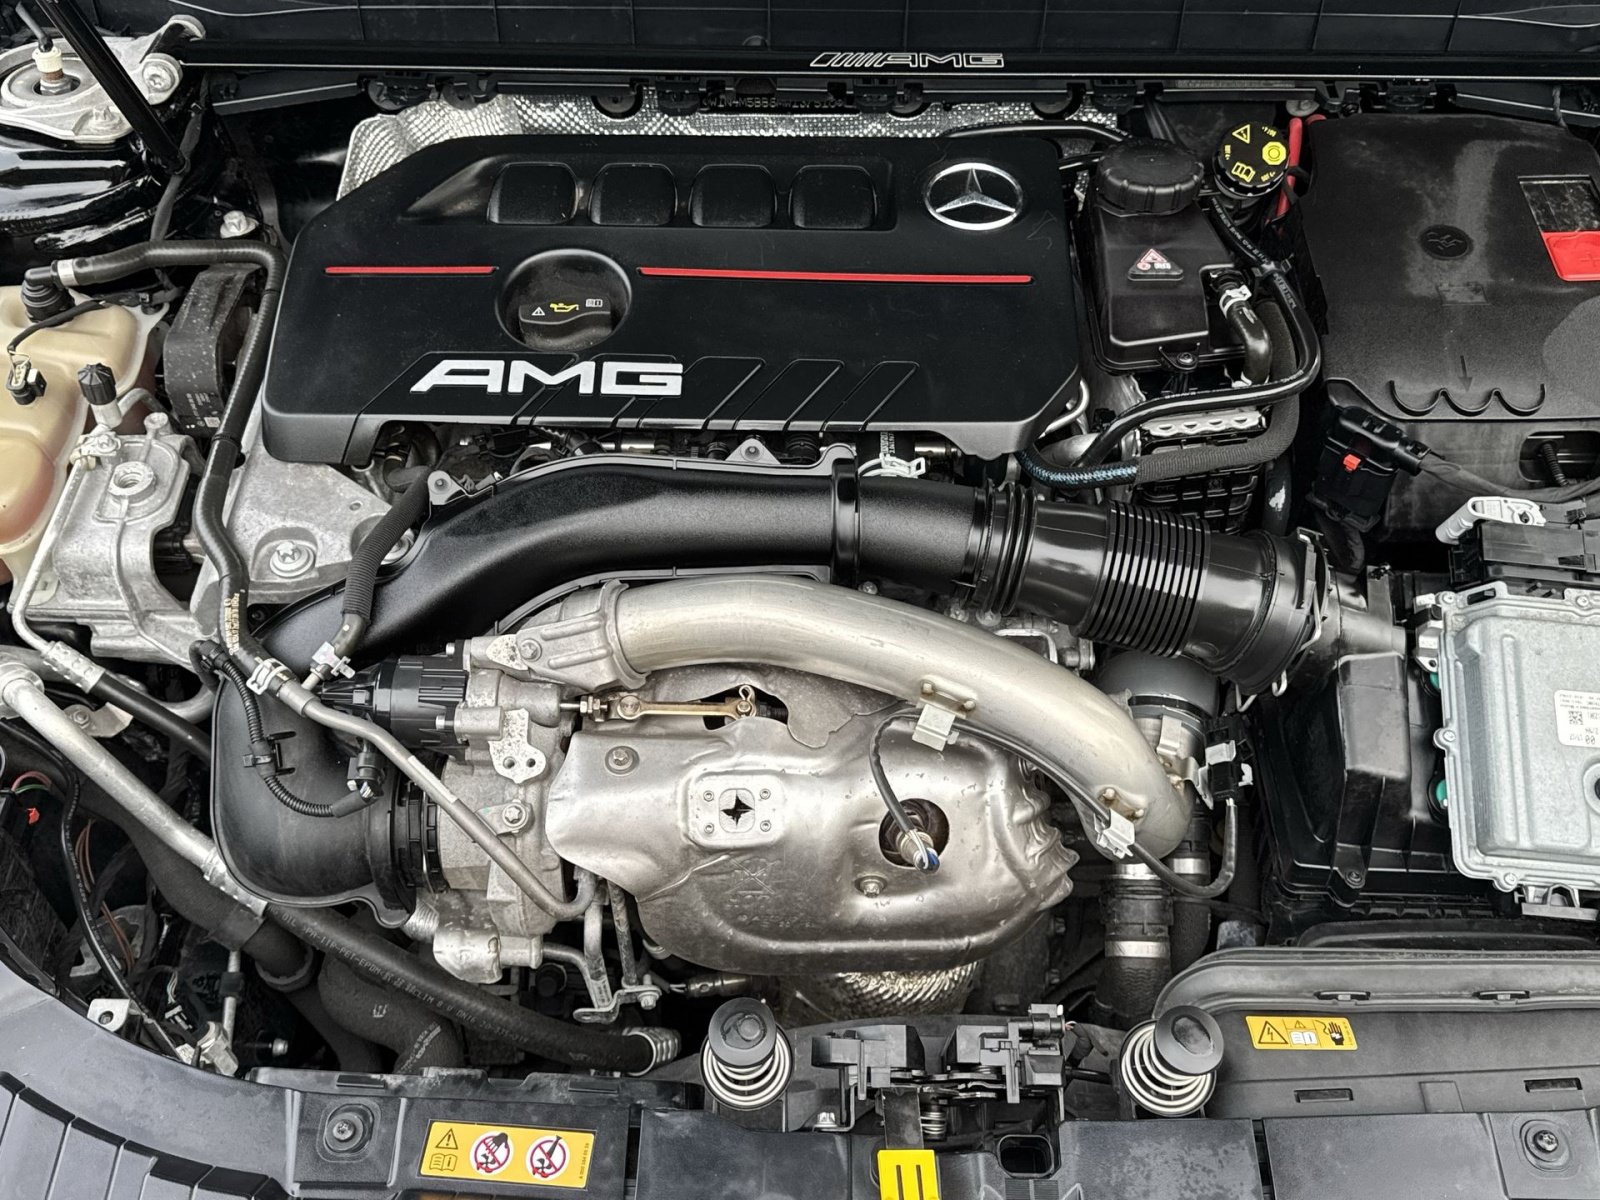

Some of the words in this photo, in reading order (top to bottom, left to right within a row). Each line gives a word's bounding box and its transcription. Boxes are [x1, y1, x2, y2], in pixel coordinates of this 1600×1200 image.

[873, 52, 1005, 68] AMG
[409, 360, 683, 396] AMG
[282, 912, 297, 927] OIL
